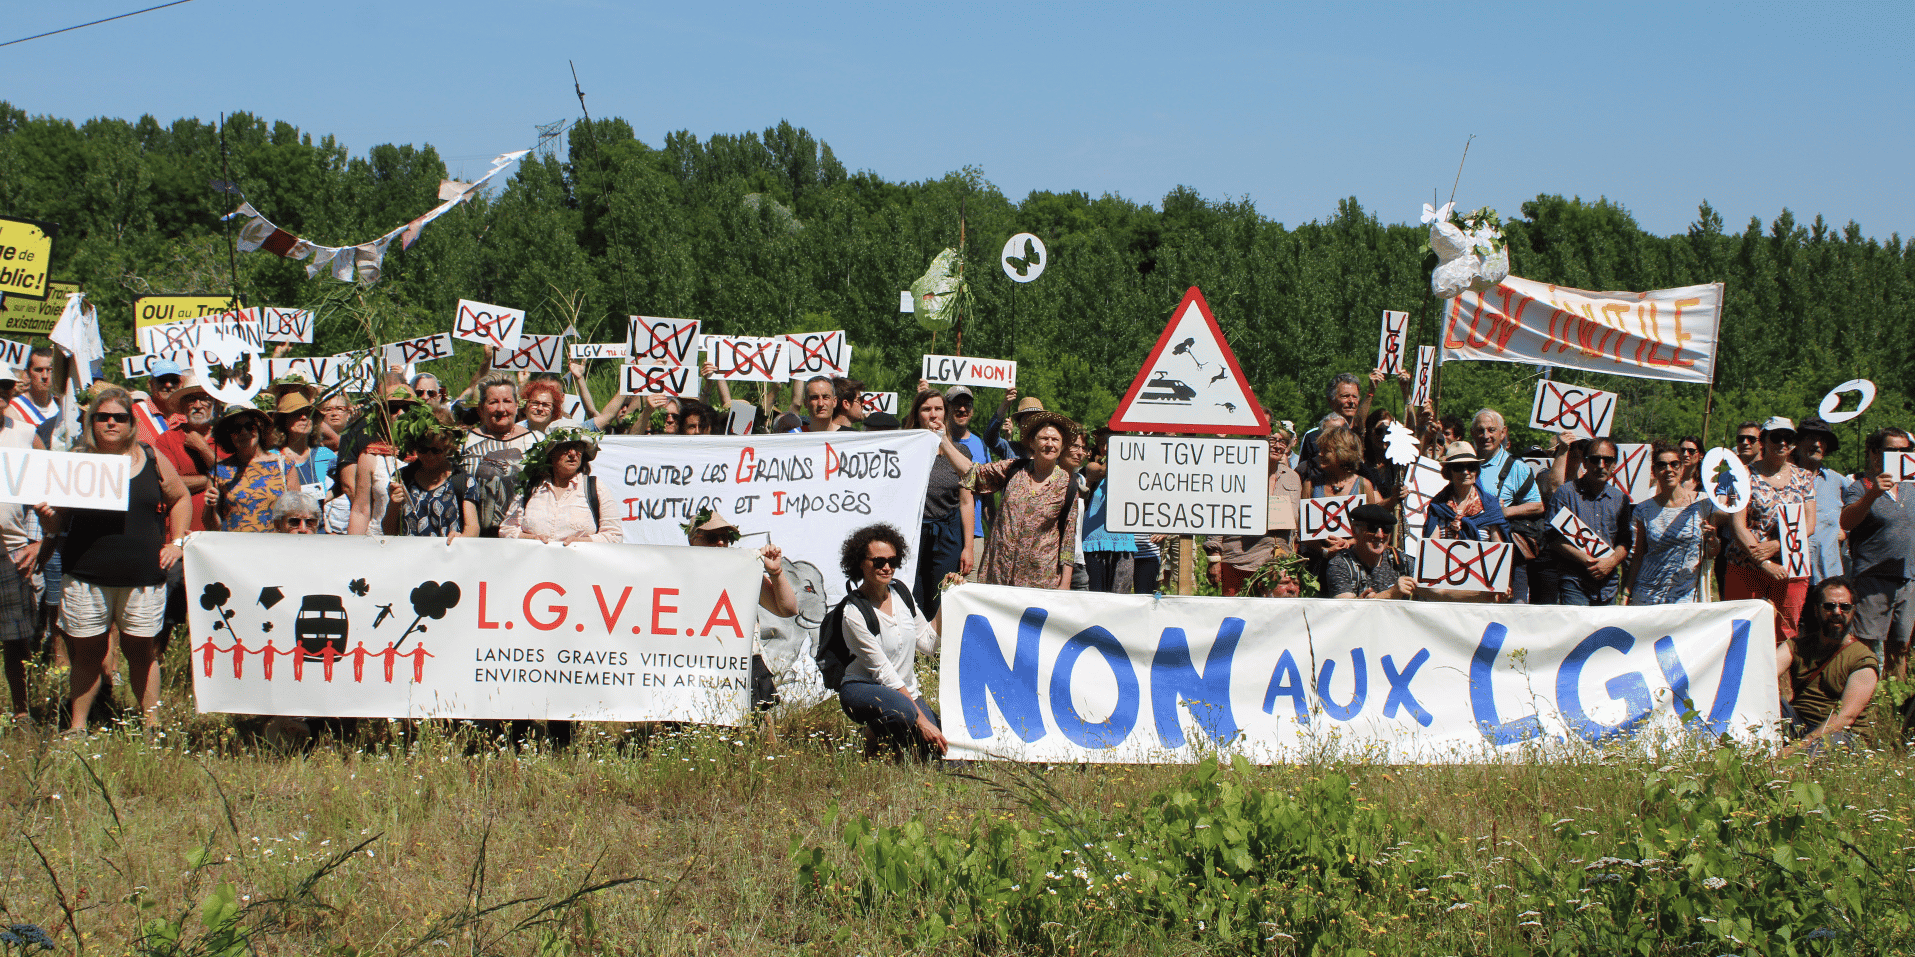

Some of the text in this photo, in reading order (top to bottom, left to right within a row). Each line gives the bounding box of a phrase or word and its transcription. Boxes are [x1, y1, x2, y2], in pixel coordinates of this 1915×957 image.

[18, 250, 35, 262] de
[142, 304, 175, 320] OUI
[178, 310, 192, 319] au
[266, 312, 308, 337] LGV
[457, 306, 516, 341] LGV
[1542, 286, 1700, 367] INUTILE
[396, 335, 448, 363] TSE
[576, 345, 602, 358] LGV
[631, 320, 698, 362] LGV
[789, 333, 842, 373] LGV
[1385, 311, 1401, 374] LGV
[714, 341, 782, 376] LGV
[926, 357, 967, 382] LGV
[626, 367, 690, 394] LGV
[863, 392, 892, 412] GV
[1536, 383, 1612, 437] LGV
[1120, 442, 1260, 465] UN TGV PEUT
[44, 459, 124, 500] NON
[1138, 471, 1246, 493] CACHER UN
[1124, 501, 1252, 529] DESASTRE
[1560, 514, 1610, 559] LGV
[1783, 505, 1804, 577] LGV
[1418, 540, 1509, 588] LGV
[478, 581, 744, 638] L.G.V.E.A
[475, 647, 748, 671] LANDES GRAVES VITICULTURE
[475, 668, 635, 686] ENVIRONNEMENT
[643, 672, 666, 687] EN
[958, 606, 1750, 748] NON AUX LGV
